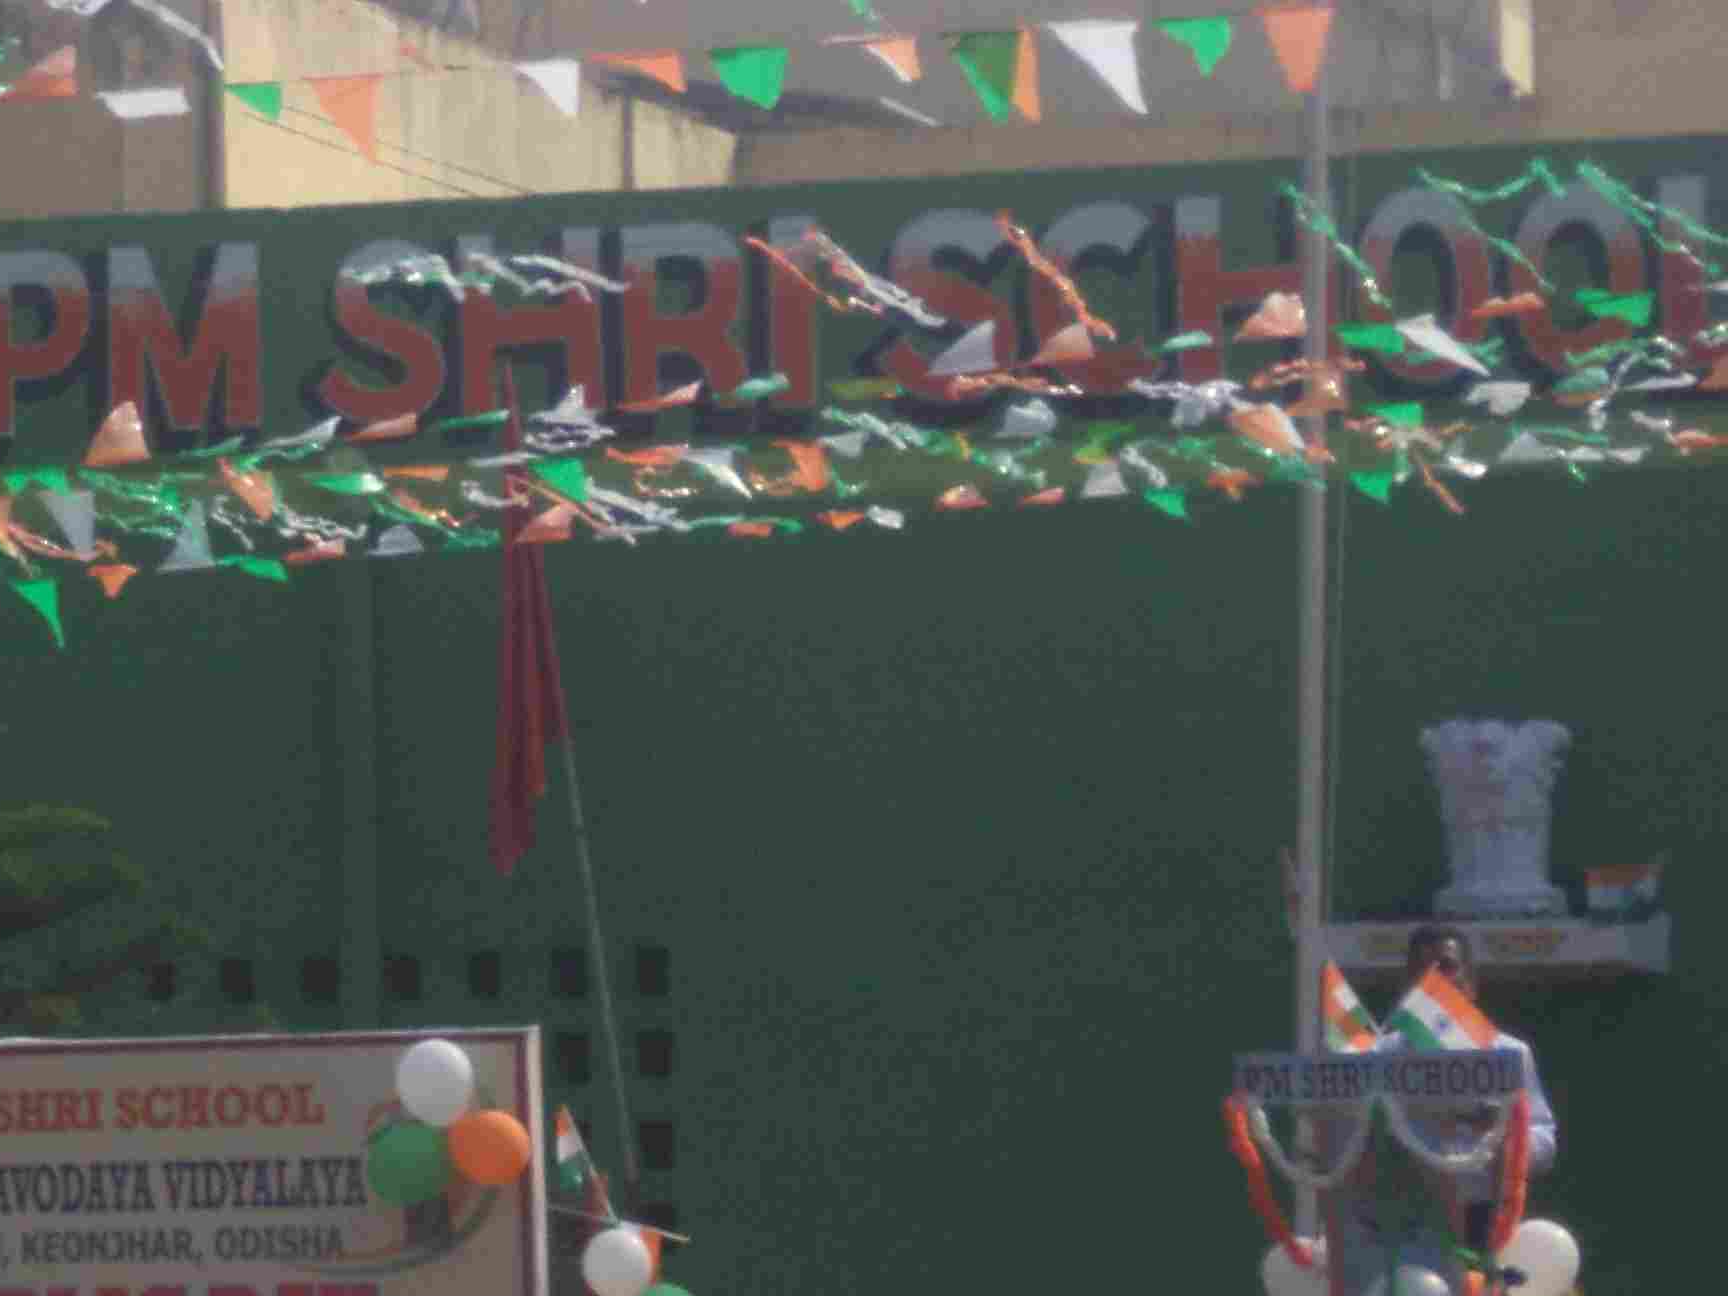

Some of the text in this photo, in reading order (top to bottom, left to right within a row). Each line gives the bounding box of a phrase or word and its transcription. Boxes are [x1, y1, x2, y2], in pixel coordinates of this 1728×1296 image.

[320, 213, 818, 428] SHRI
[115, 1083, 325, 1129] SCHOOL
[163, 1155, 367, 1208] VIDYALAYA
[21, 1230, 203, 1266] KEONJHAR,
[214, 1226, 344, 1262] ODISHA
